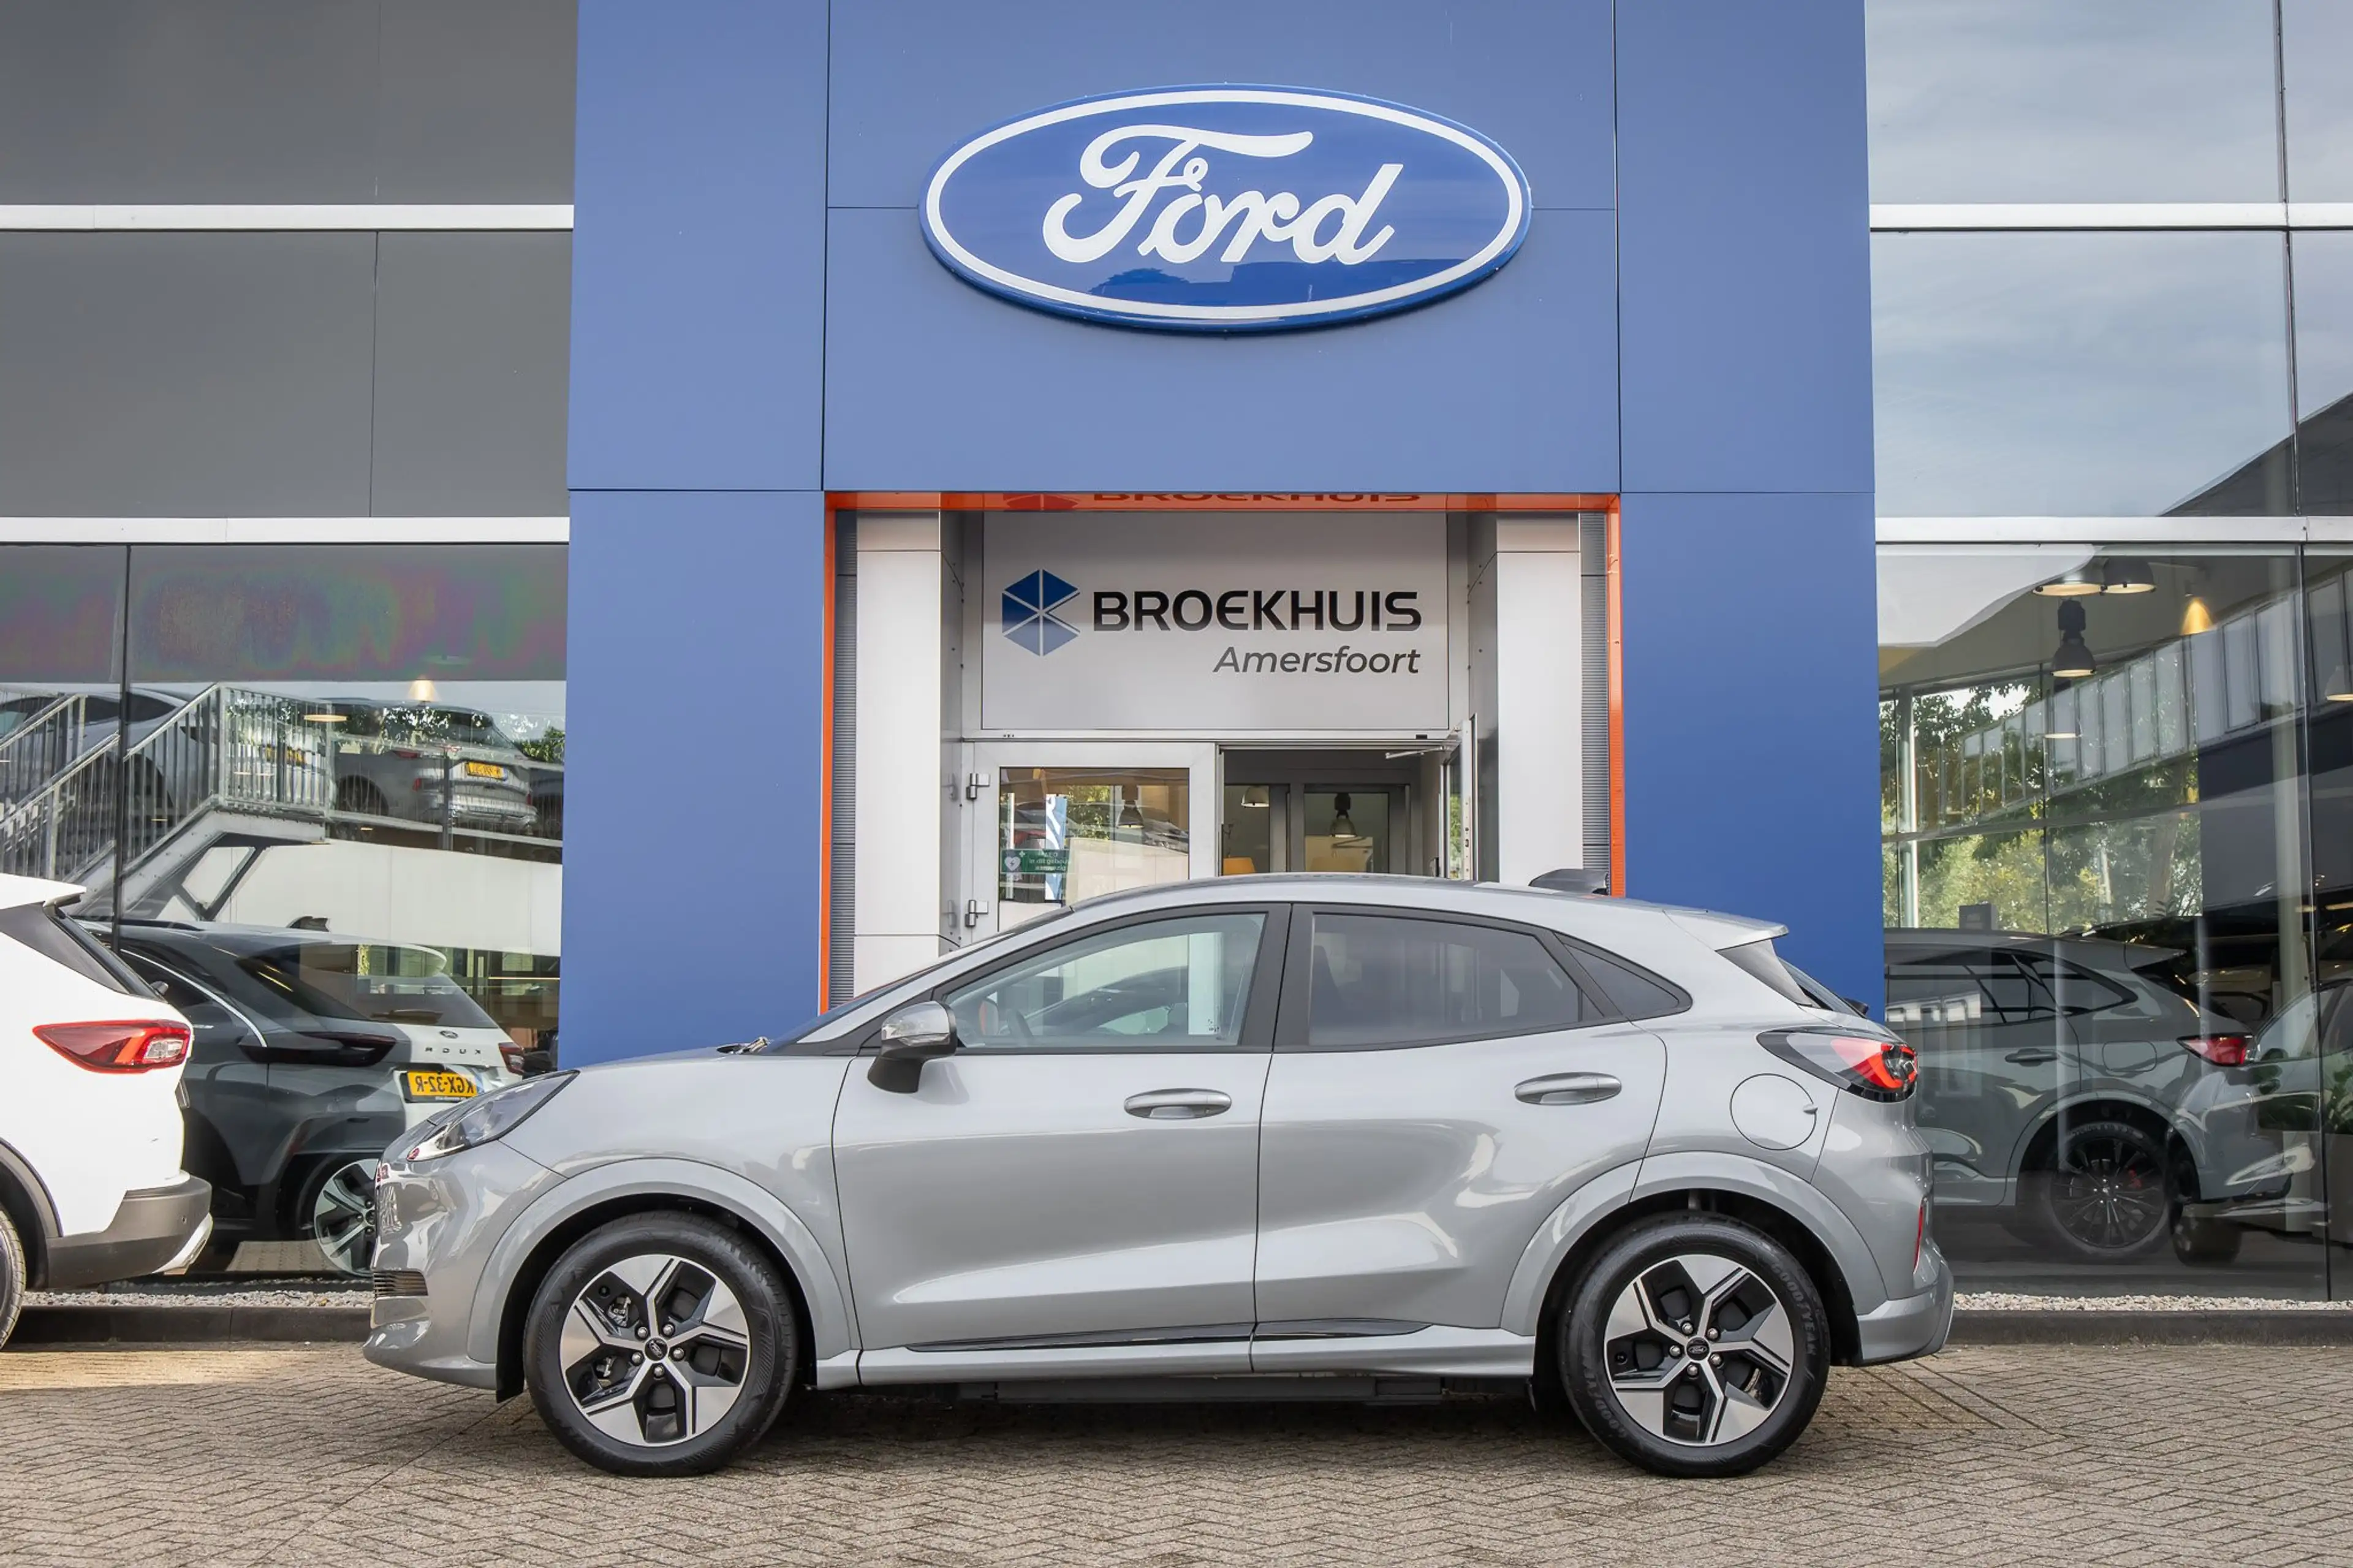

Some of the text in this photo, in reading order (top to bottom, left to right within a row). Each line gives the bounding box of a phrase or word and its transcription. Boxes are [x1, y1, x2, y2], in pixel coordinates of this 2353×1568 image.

[1042, 124, 1404, 265] Ford
[1094, 589, 1422, 631] BROEKHUIS
[1213, 646, 1421, 674] Amersfoort
